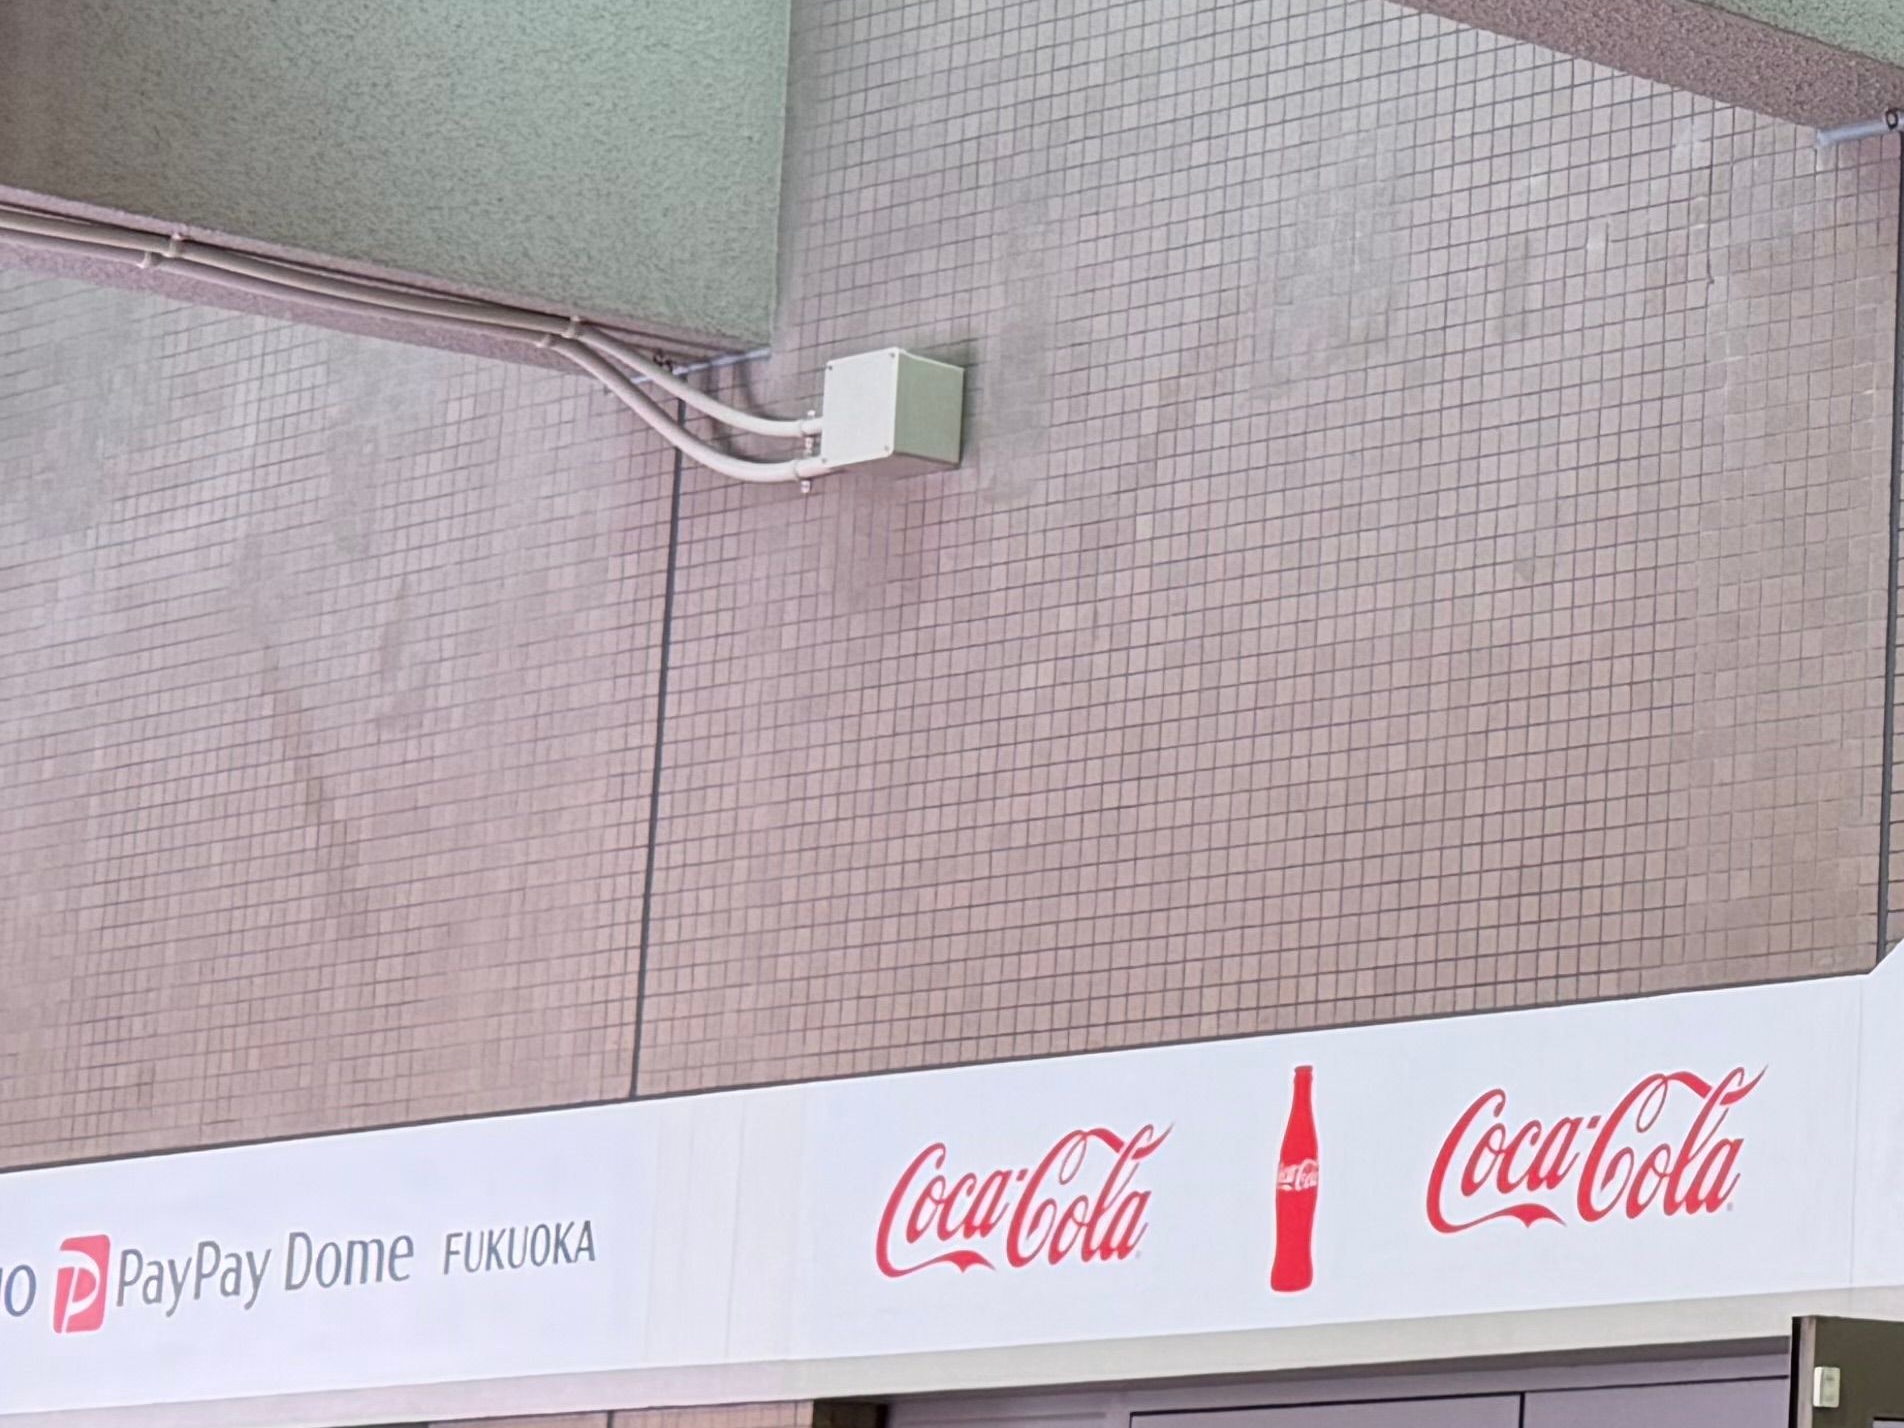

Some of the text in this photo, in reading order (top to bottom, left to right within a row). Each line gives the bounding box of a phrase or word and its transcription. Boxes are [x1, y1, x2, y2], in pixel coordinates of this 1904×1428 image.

[875, 1122, 1175, 1278] Coca-Cola
[1425, 1064, 1769, 1235] Coca-Cola
[116, 1240, 272, 1317] PayPay
[284, 1232, 414, 1291] Dome
[443, 1220, 596, 1275] FUKUOKA
